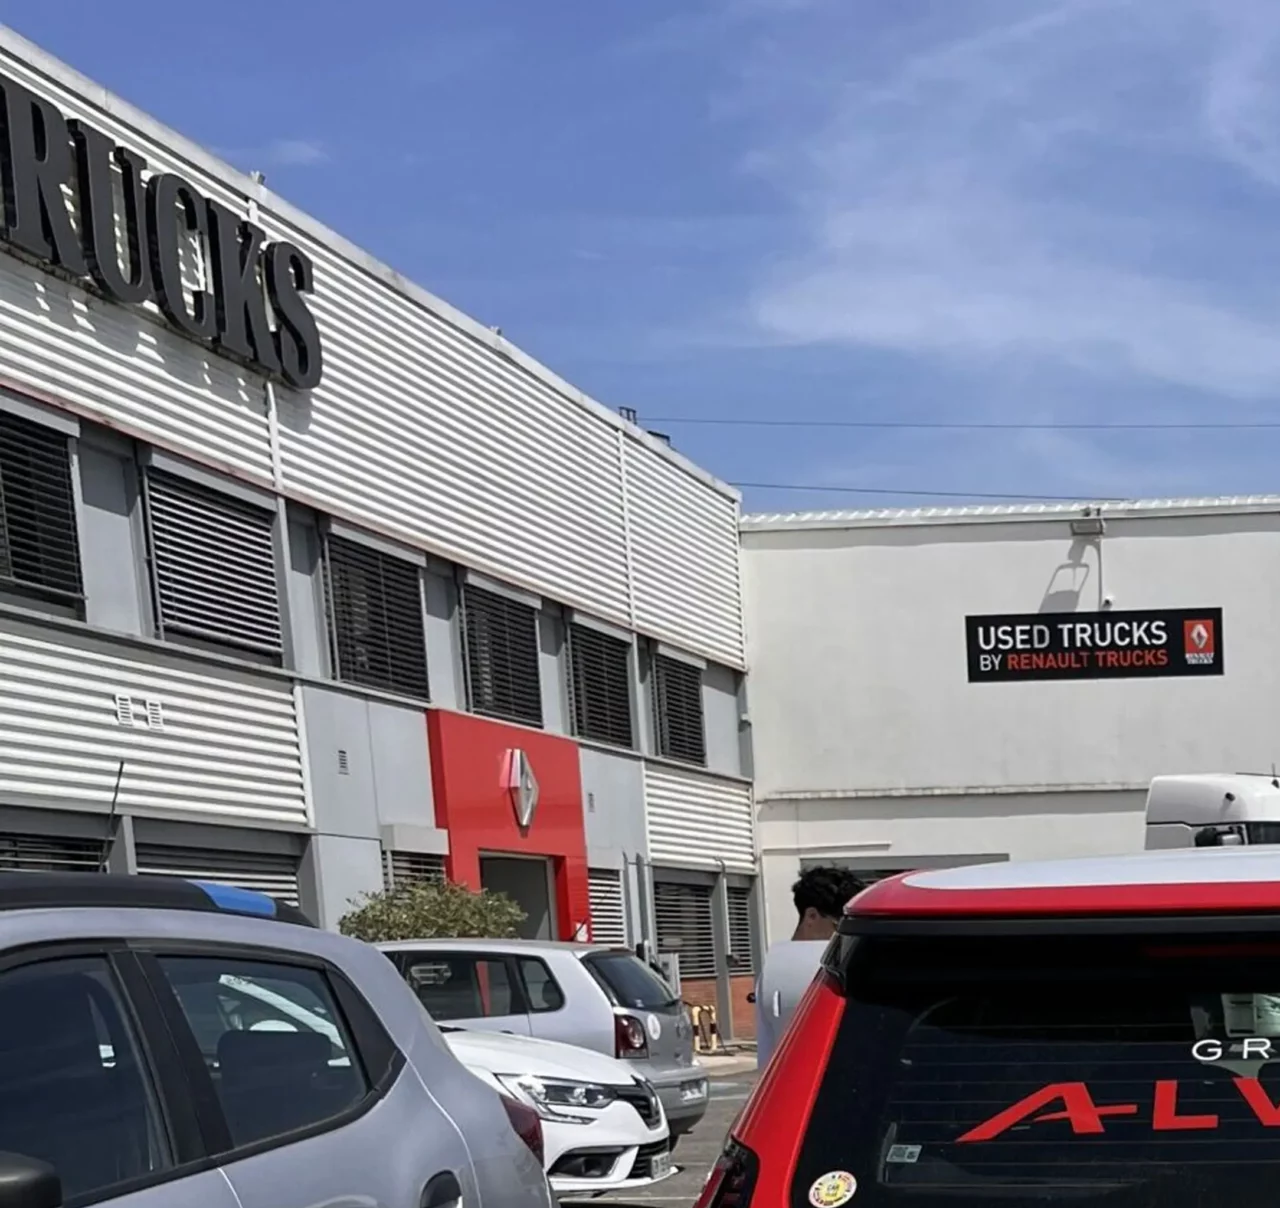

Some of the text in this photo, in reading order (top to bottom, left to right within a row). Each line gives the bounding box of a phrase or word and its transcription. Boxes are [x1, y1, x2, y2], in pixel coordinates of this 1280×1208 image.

[978, 621, 1168, 650] USED TRUCKS
[980, 654, 1002, 671] BY
[1007, 651, 1090, 670] RENAULT
[1095, 649, 1168, 668] TRUCKS
